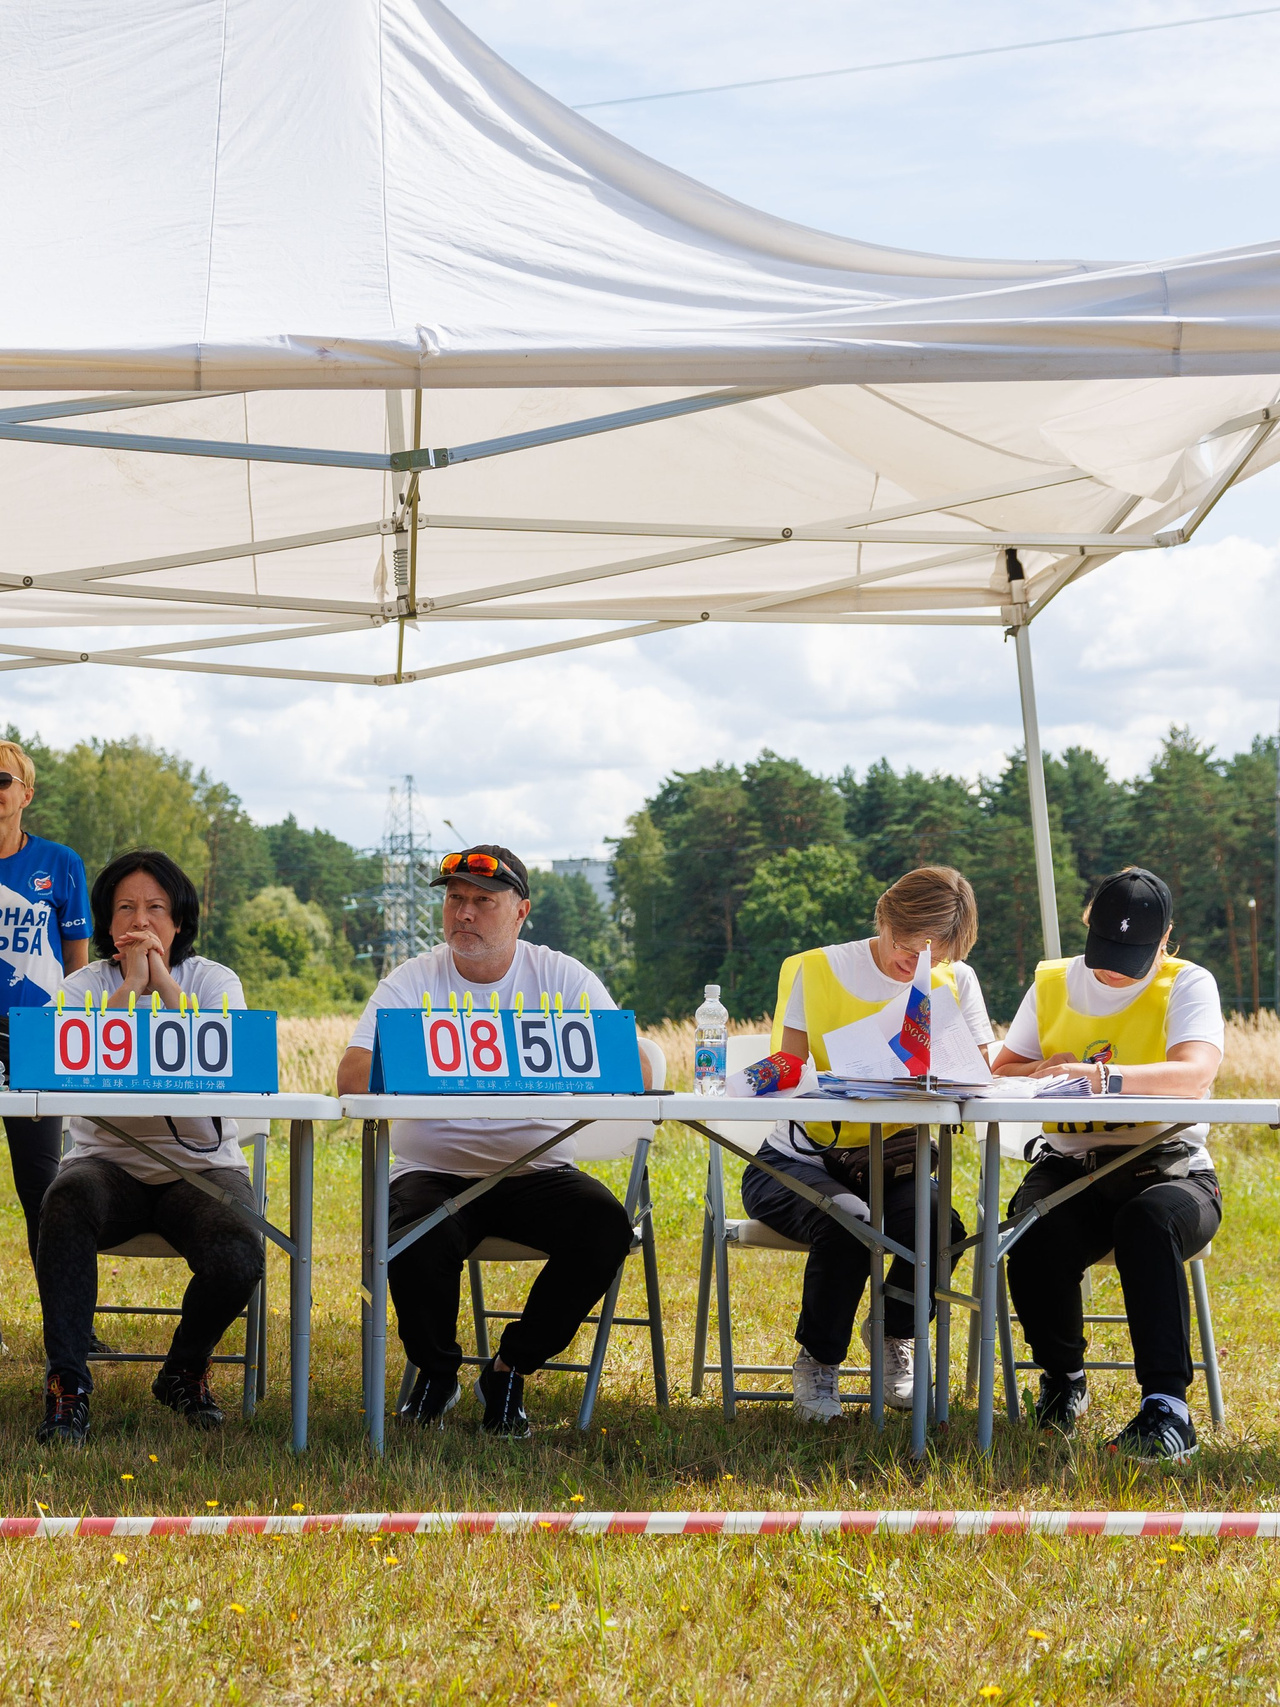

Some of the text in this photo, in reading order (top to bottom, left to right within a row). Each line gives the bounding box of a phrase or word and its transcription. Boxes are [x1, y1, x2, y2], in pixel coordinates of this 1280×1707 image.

[59, 1018, 228, 1072] 09 00
[429, 1019, 594, 1073] 08 50
